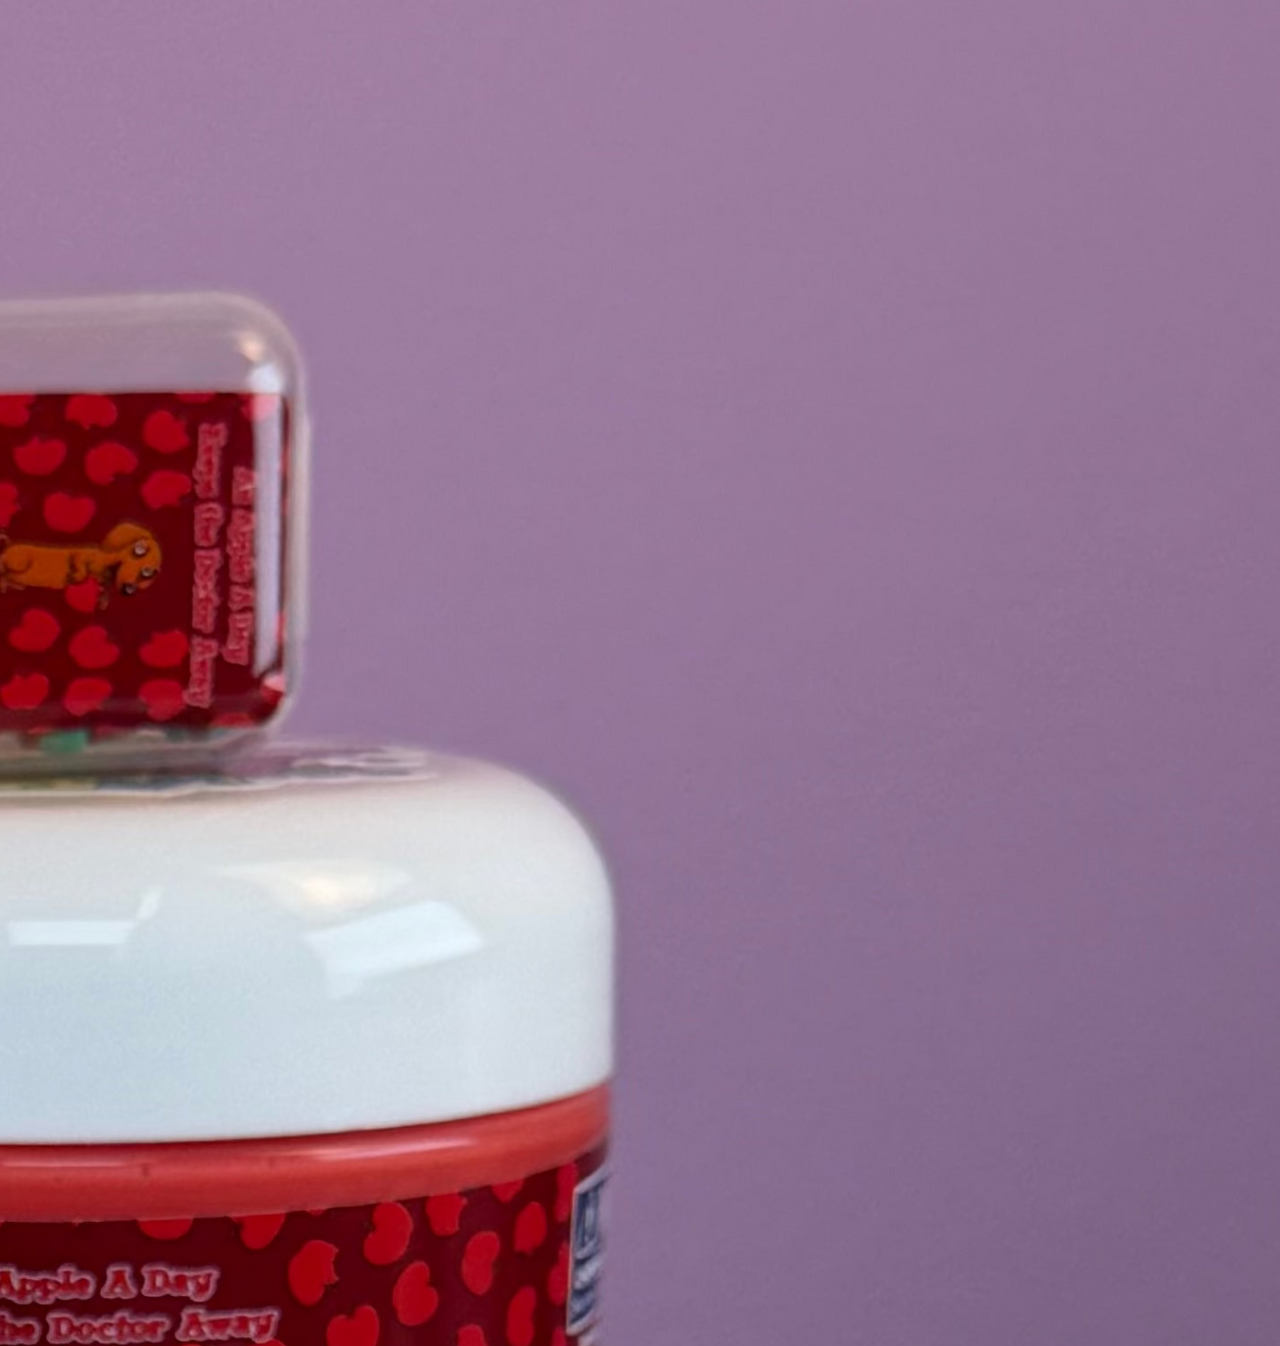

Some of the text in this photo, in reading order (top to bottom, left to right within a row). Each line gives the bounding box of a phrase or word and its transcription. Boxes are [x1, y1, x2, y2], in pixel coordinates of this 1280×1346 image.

[100, 1263, 137, 1299] A
[141, 1262, 221, 1302] Day
[46, 1309, 171, 1346] Doctor
[175, 1306, 281, 1344] Away
